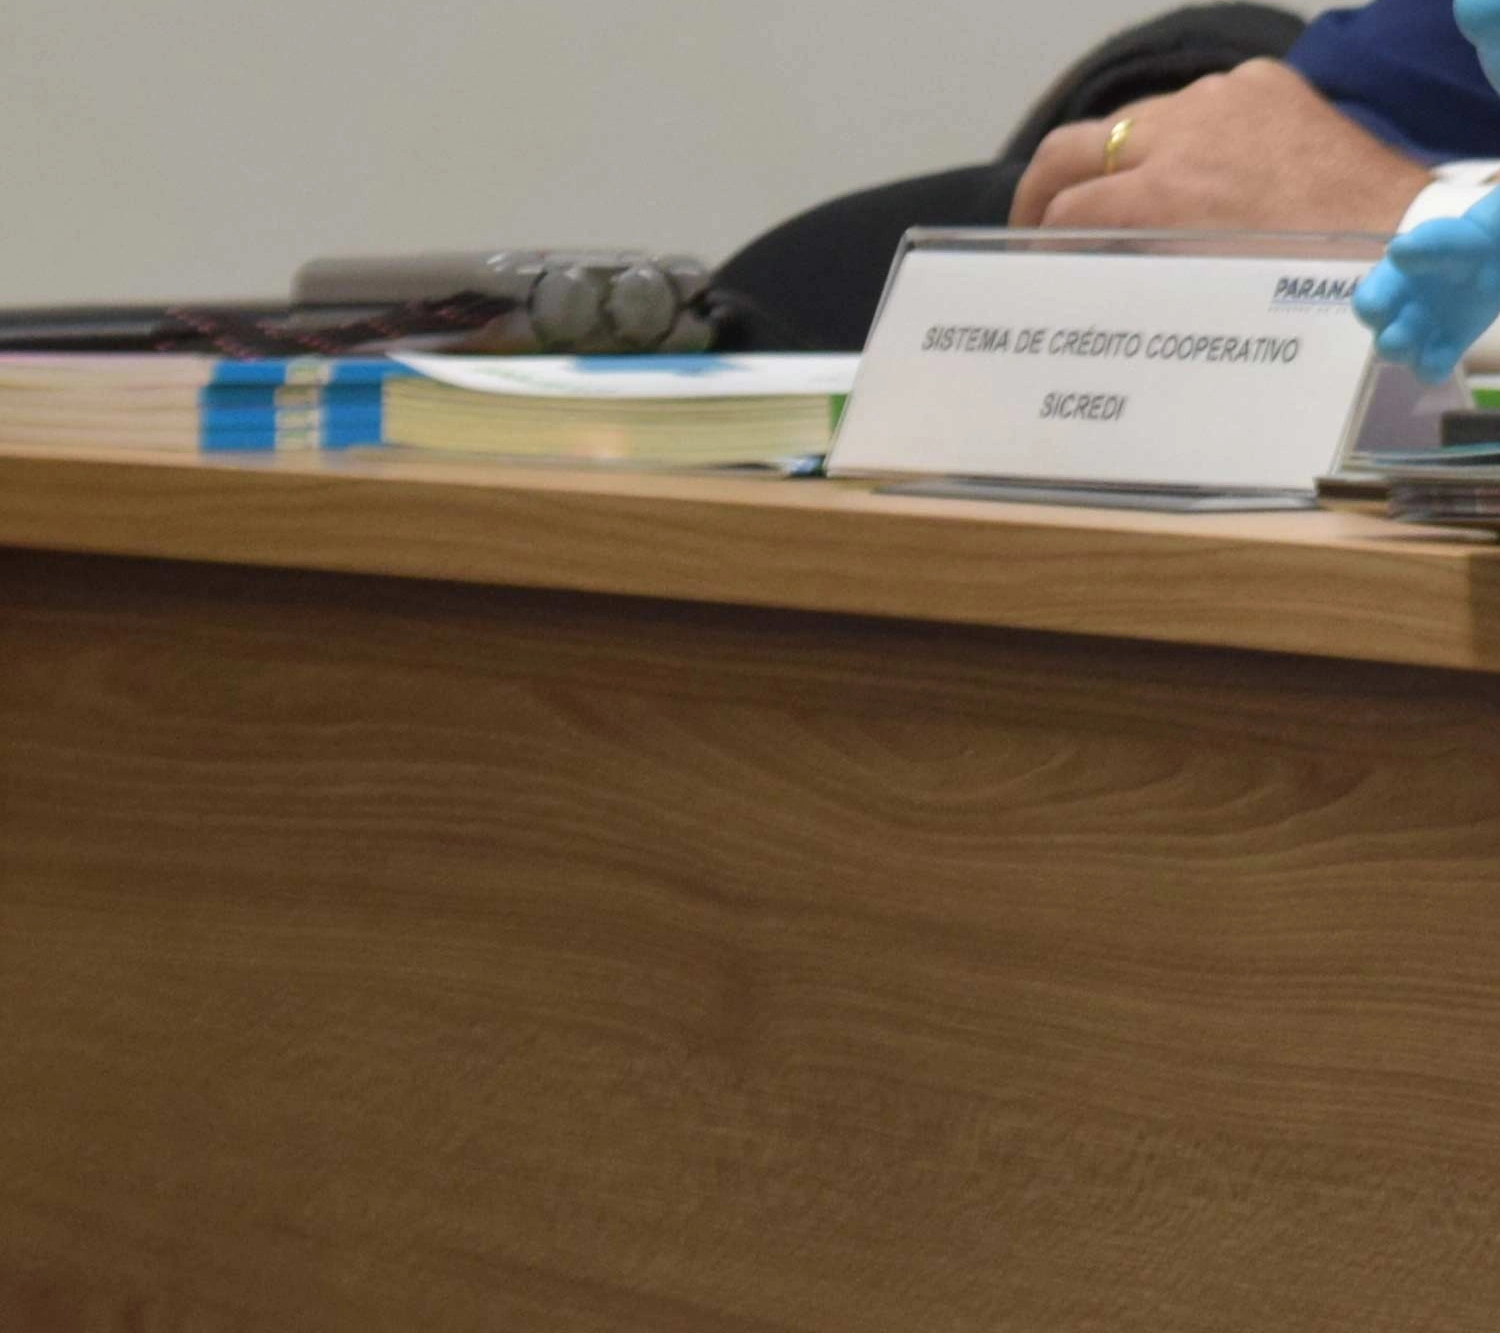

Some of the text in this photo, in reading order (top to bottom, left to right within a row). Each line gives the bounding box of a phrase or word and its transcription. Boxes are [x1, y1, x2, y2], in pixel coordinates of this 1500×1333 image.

[922, 326, 1301, 364] SISTEMA DE CRÉDITO COOPERATIVO
[1039, 392, 1126, 421] SICREDI
